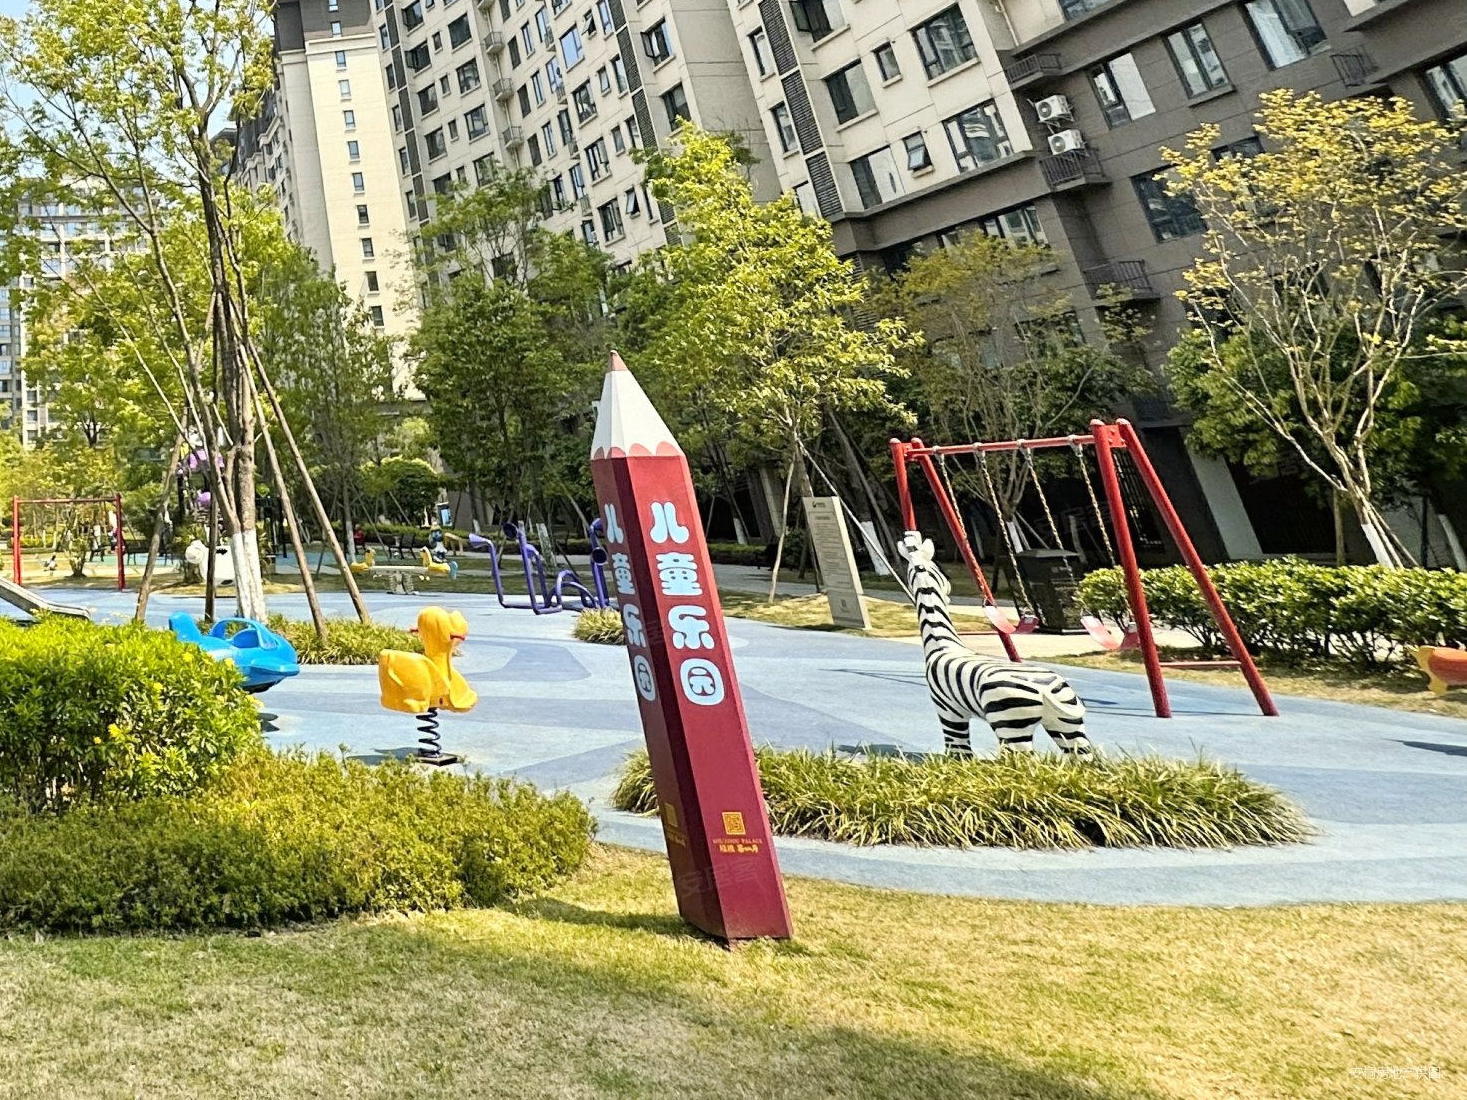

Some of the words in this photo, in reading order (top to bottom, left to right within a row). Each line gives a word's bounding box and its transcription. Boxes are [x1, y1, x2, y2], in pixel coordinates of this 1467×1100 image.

[604, 503, 656, 701] 儿童乐园
[650, 501, 725, 705] 儿童乐园
